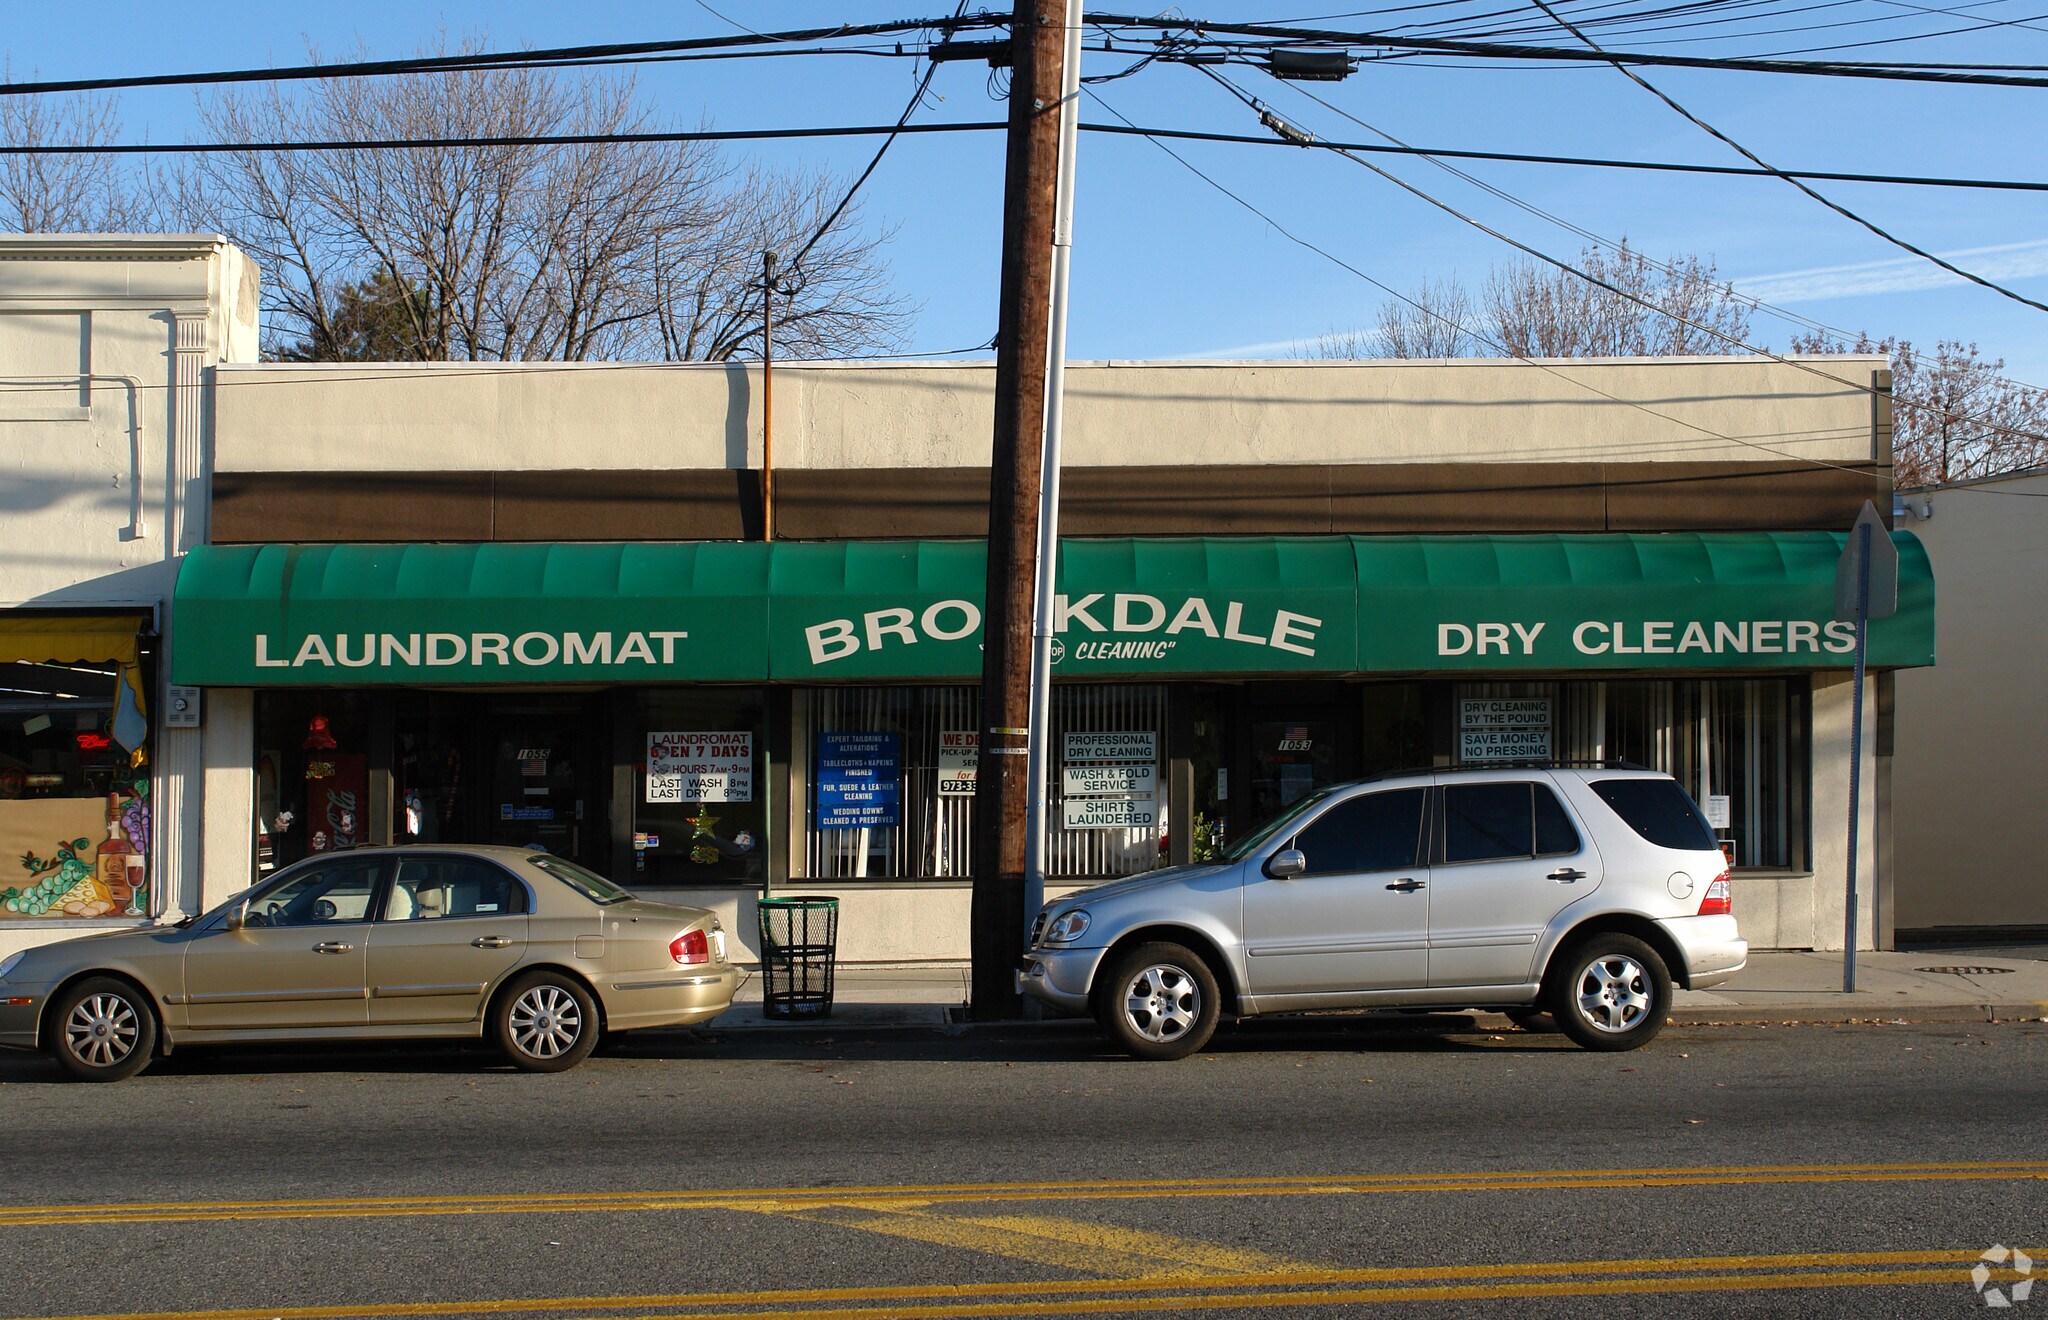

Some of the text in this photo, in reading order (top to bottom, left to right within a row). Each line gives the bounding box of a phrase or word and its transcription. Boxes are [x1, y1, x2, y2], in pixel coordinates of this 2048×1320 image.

[803, 593, 1323, 665] BROKDALE
[1438, 620, 1857, 656] DRY CLEANERS
[255, 631, 689, 668] LAUNDROMAT
[1464, 701, 1548, 713] DRY CLEANING
[1465, 713, 1548, 724] BY THE POUND
[652, 734, 748, 745] LAUNDROMAT
[827, 735, 850, 743] EXPERT
[943, 734, 963, 746] WE
[1068, 735, 1153, 745] PROFESSIONAL
[1464, 733, 1547, 745] SAVE MONEY
[839, 744, 879, 752] ALTERATIONS
[1281, 741, 1310, 750] 1053
[1465, 744, 1548, 757] NO PRESSING
[520, 750, 549, 759] 1055
[696, 746, 706, 758] 7
[711, 746, 750, 758] DAYS
[940, 748, 972, 756] PICK-UP
[1068, 746, 1152, 757] DRY CLEANING
[823, 759, 863, 767] TABLECLOTHS
[868, 759, 894, 767] NAPKINS
[962, 759, 979, 767] SER
[672, 764, 708, 774] HOURS
[845, 769, 873, 777] FINISHED
[1069, 768, 1150, 780] WASH & FOLD
[956, 770, 972, 780] for
[651, 779, 682, 788] LAST
[688, 779, 723, 788] WASH
[839, 783, 859, 791] SUEDE
[860, 783, 867, 791] &
[868, 783, 894, 791] LEATHER
[942, 781, 977, 791] 973-33
[1083, 779, 1137, 791] SERVICE
[651, 789, 682, 798] LAST
[686, 789, 710, 798] DRY
[844, 793, 873, 801] CLEANING
[833, 806, 884, 816] WEDDING GOWNS
[1085, 801, 1135, 812] SHIRTS
[823, 816, 894, 826] CLEANED & PRESERVED
[1068, 813, 1152, 825] LAUNDERED
